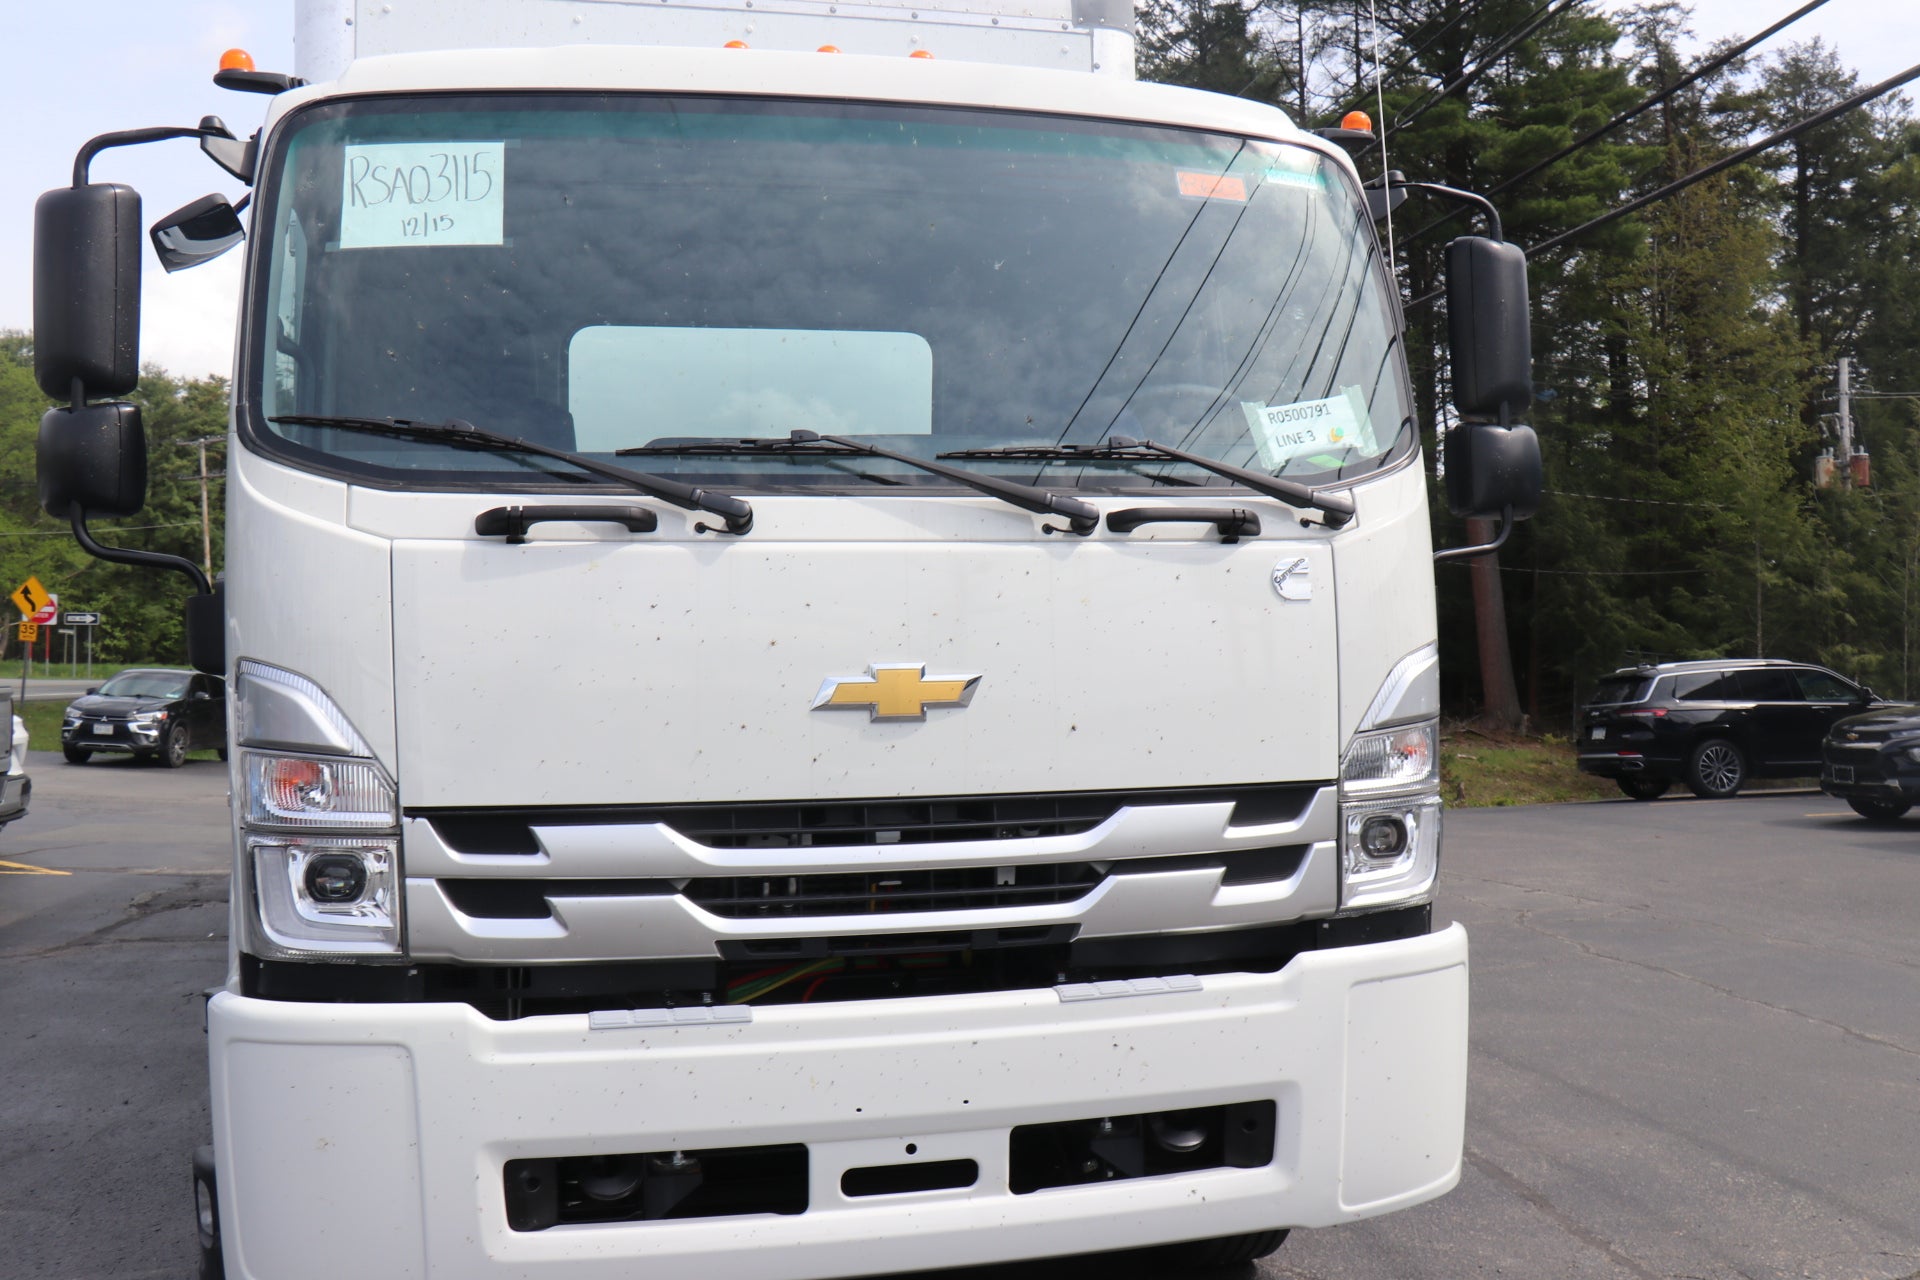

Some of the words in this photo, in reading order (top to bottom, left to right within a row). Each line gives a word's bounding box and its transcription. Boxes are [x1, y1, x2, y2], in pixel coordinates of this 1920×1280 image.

[350, 151, 492, 208] RSA03115
[401, 212, 454, 237] 12/15
[1275, 432, 1305, 448] LINE
[1306, 430, 1316, 442] 3
[20, 623, 36, 635] 35
